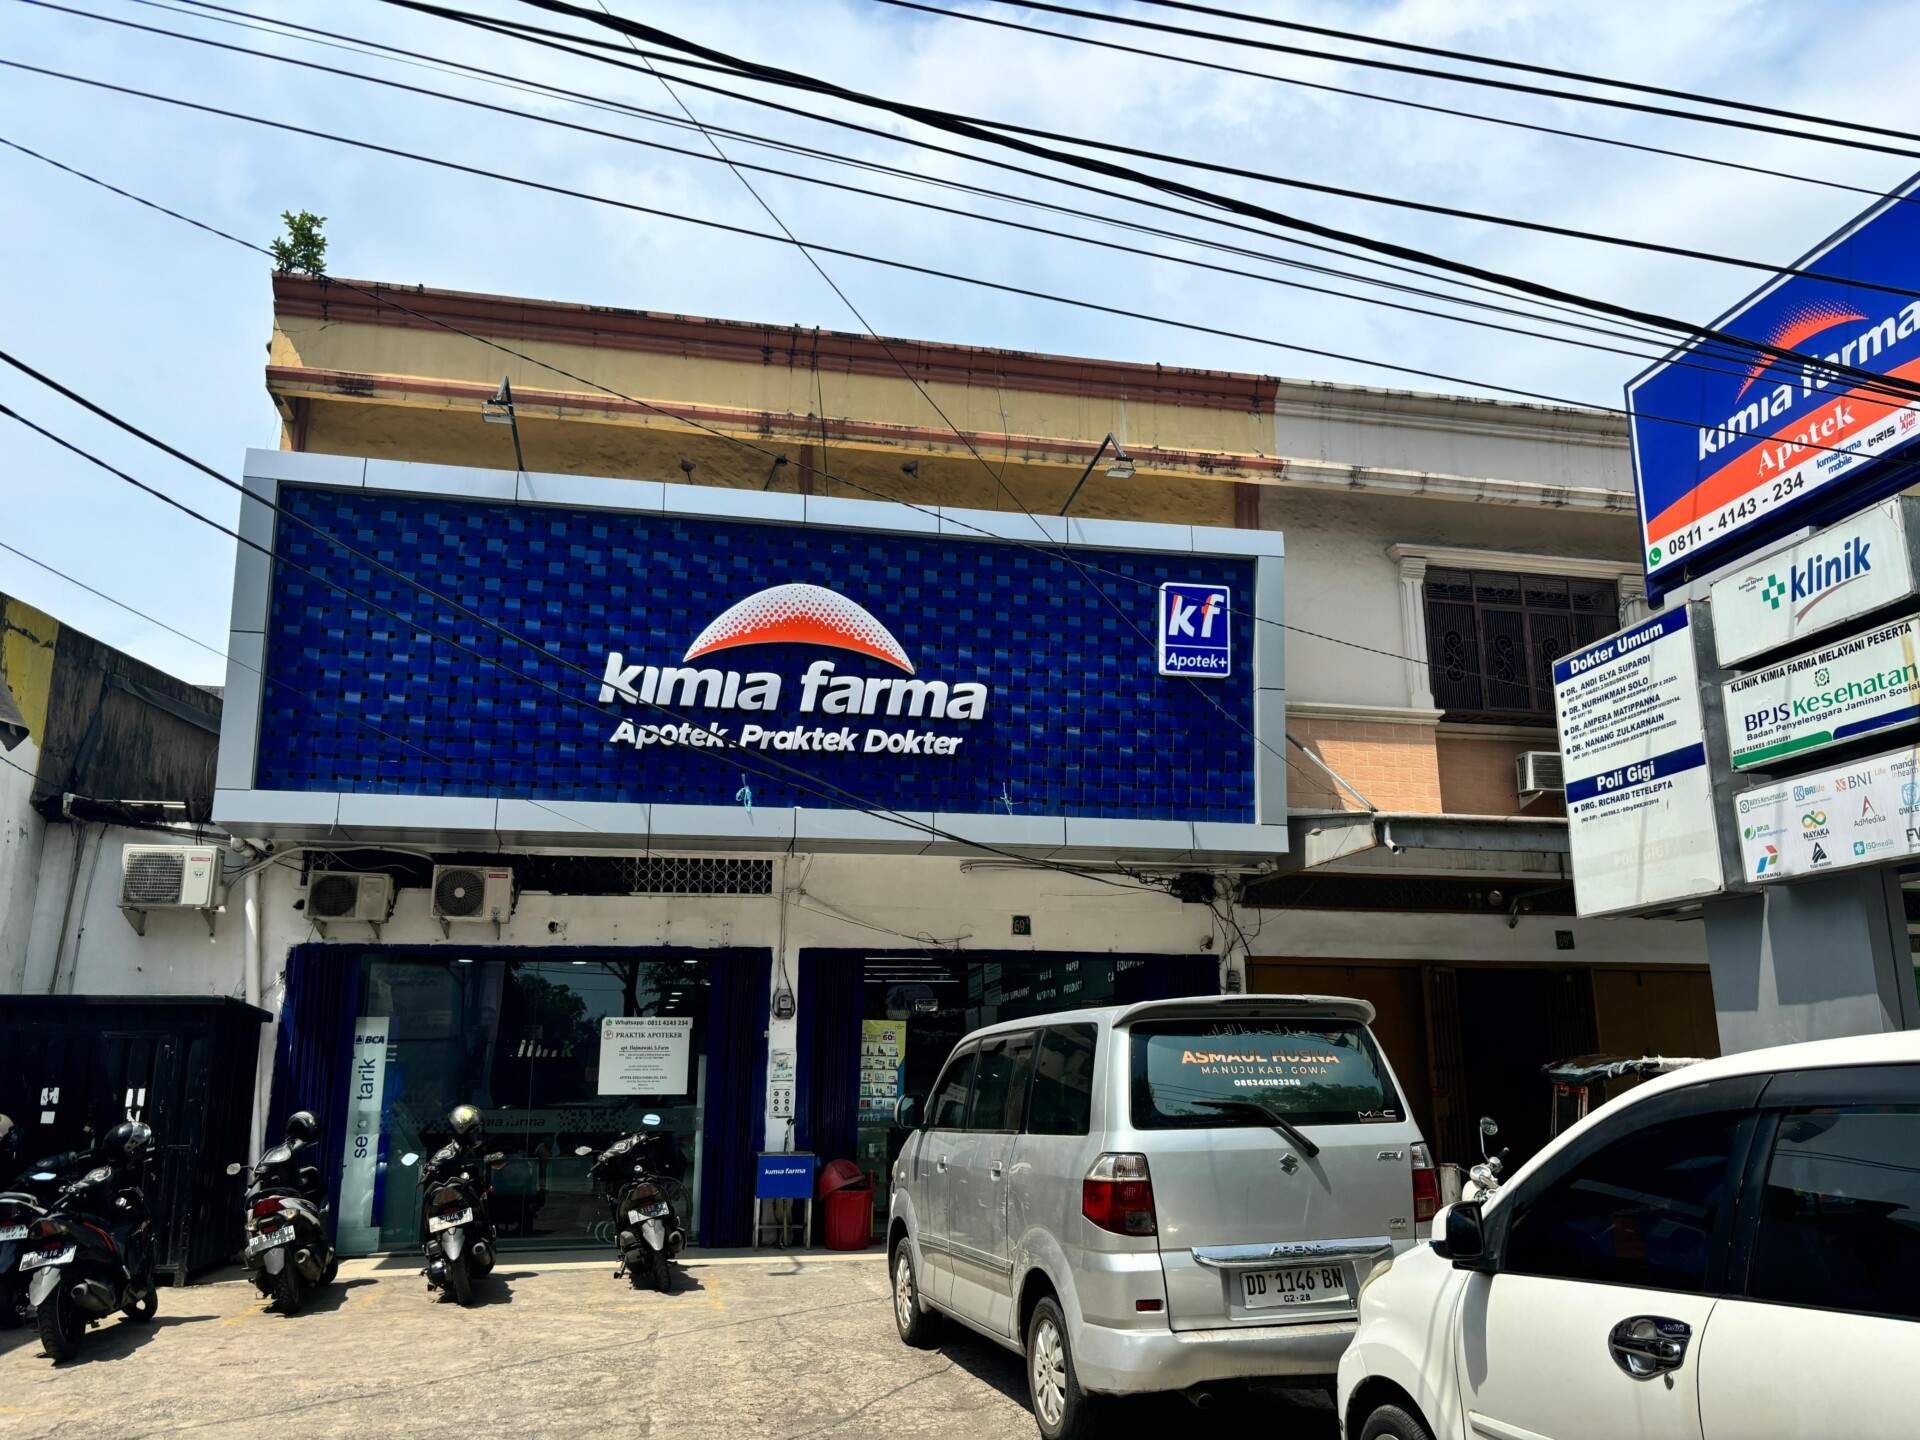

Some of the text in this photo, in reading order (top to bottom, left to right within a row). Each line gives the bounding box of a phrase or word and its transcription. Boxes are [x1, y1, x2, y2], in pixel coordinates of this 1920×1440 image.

[1699, 385, 1792, 461] kimia
[1758, 404, 1857, 476] Apotek
[1828, 456, 1852, 474] mobile
[1669, 526, 1702, 555] 0811
[1718, 498, 1757, 529] 4143
[1773, 471, 1804, 502] 234
[1791, 536, 1871, 602] klinik
[1168, 594, 1224, 638] kf
[1166, 652, 1227, 670] Apotek+
[1570, 623, 1664, 675] Dokter Umum
[1730, 623, 1912, 693] KLINIK KIMIA FARMA MELAYANI PESERTA
[598, 652, 988, 720] kimia farma
[1566, 686, 1578, 697] DR.
[1580, 678, 1598, 691] ANDI
[1599, 668, 1617, 683] ELYA
[1618, 655, 1651, 674] SUPARDI
[1569, 705, 1580, 715] DR.
[1582, 686, 1626, 710] NURHIKMAH
[1628, 677, 1649, 691] SOLO
[1570, 724, 1582, 734] DR.
[1583, 713, 1612, 730] AMPERA
[1614, 694, 1660, 718] MATIPPANNA
[1745, 663, 1919, 731] BPJS Kesehatan
[1572, 743, 1584, 753] DR.
[1585, 731, 1614, 748] NANANG
[1616, 713, 1664, 737] ZULKARNAIN
[1747, 728, 1774, 742] Badan
[1776, 707, 1843, 733] Penyelenggara
[1845, 693, 1887, 712] Jaminan
[740, 724, 859, 751] Praktek
[864, 729, 963, 755] Dokter
[1581, 802, 1597, 811] DRG.
[1599, 792, 1630, 806] RICHARD
[1631, 780, 1673, 798] TETELEPTA
[1597, 761, 1655, 791] Poli Gigi
[1848, 771, 1872, 789] BNI
[1803, 828, 1830, 840] NAYAKA
[1854, 815, 1886, 827] AdMedika
[365, 1036, 384, 1044] BCA
[1182, 1049, 1340, 1064] ASMAUL HUSNA
[356, 1058, 376, 1100] tarik
[1201, 1066, 1327, 1074] MANUJU KAB. GOWA
[1270, 1244, 1326, 1257] ARENA
[1245, 1267, 1343, 1295] DD 1146 BN
